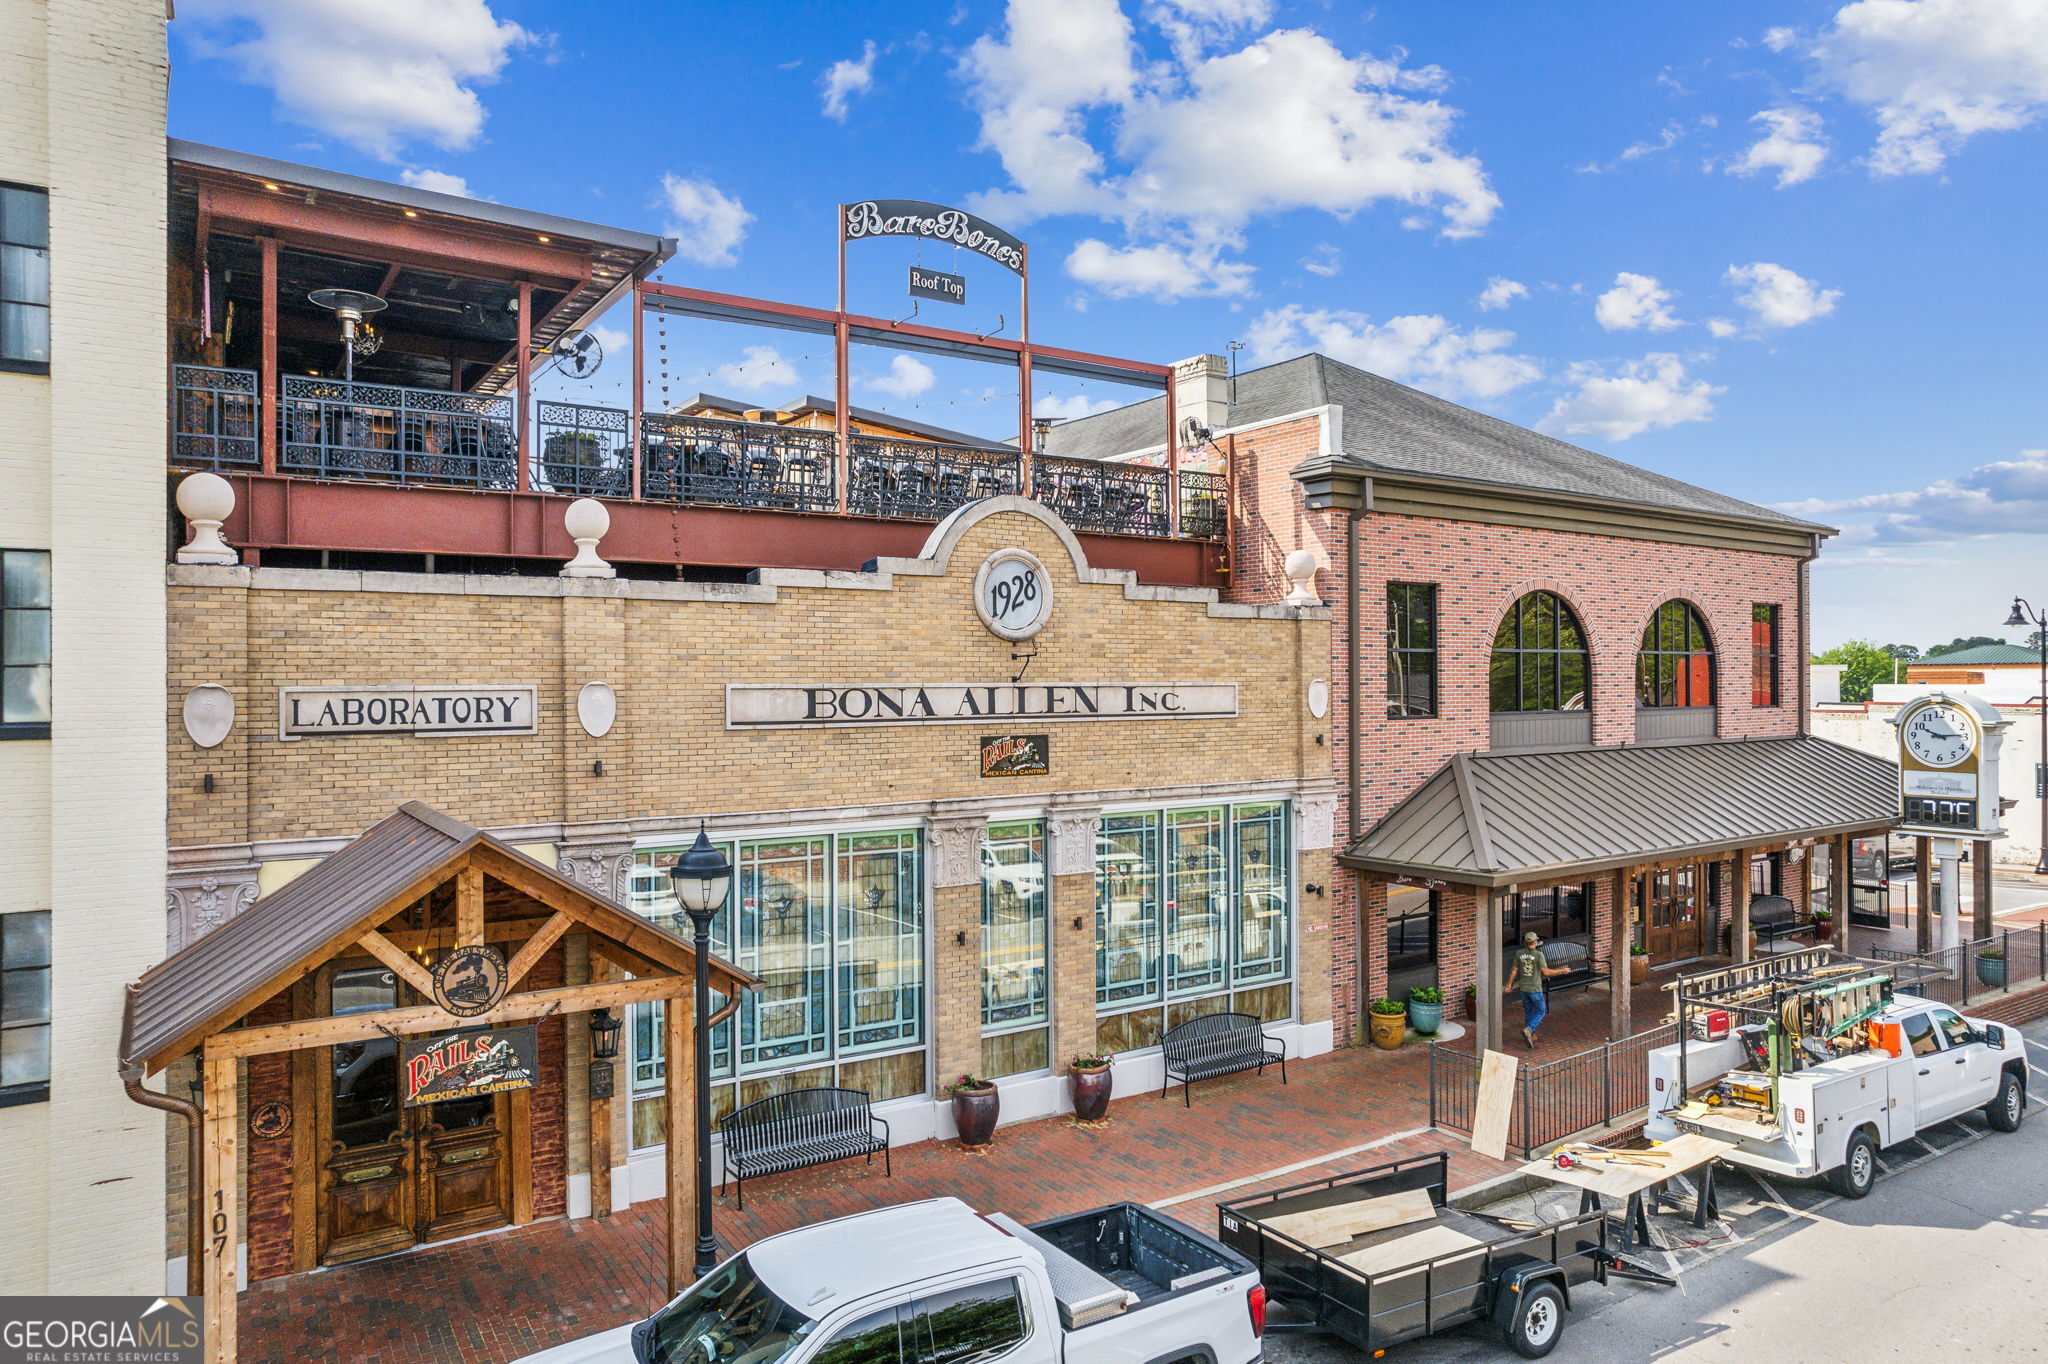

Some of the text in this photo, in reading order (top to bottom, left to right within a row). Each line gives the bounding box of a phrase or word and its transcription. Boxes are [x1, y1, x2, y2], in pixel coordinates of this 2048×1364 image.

[911, 271, 964, 300] Roof Top
[990, 570, 1037, 620] 1928
[801, 687, 938, 720] BONA
[953, 685, 1099, 717] ALLEN
[291, 696, 520, 727] LABORATORY
[1934, 710, 1945, 719] 12
[1922, 713, 1932, 722] 11
[1950, 714, 1955, 722] 1
[1914, 722, 1925, 731] 10
[1959, 722, 1965, 731] 2
[1910, 731, 1917, 740] 9
[1962, 732, 1969, 741] 3
[1914, 741, 1921, 750] 8
[1958, 743, 1965, 752] 4
[982, 738, 1027, 774] RAILS
[1923, 749, 1930, 758] 7
[1936, 753, 1943, 763] 6
[1950, 751, 1956, 760] 5
[435, 946, 507, 989] OFF THE RAILS MEXICAN
[426, 1034, 459, 1053] OFF THE
[406, 1035, 494, 1101] RAILS
[416, 1078, 533, 1105] MEXICAN CANTINA
[212, 1189, 228, 1258] 107
